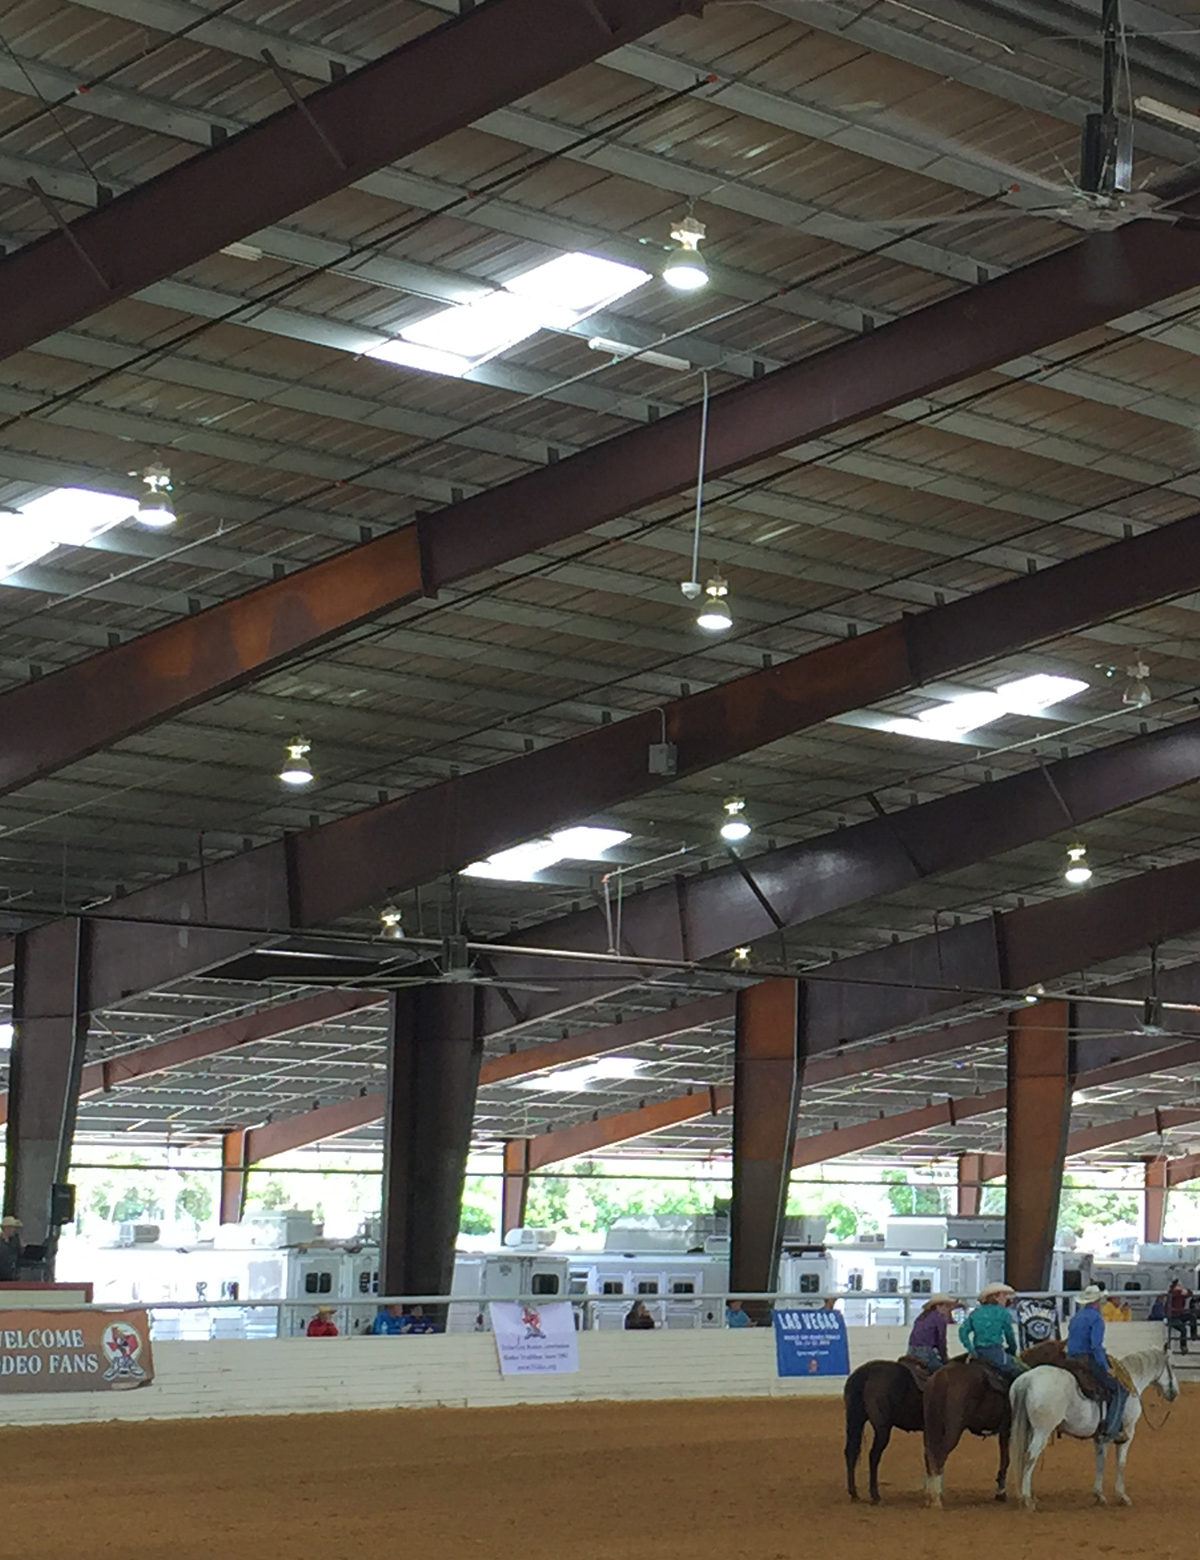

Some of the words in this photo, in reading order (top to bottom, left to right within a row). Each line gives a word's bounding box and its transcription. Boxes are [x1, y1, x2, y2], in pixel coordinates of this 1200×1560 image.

[777, 1312, 802, 1330] LAS
[801, 1312, 840, 1330] VEGAS
[0, 1329, 84, 1348] ELCOME
[0, 1355, 42, 1375] DEO
[48, 1354, 98, 1374] FANS
